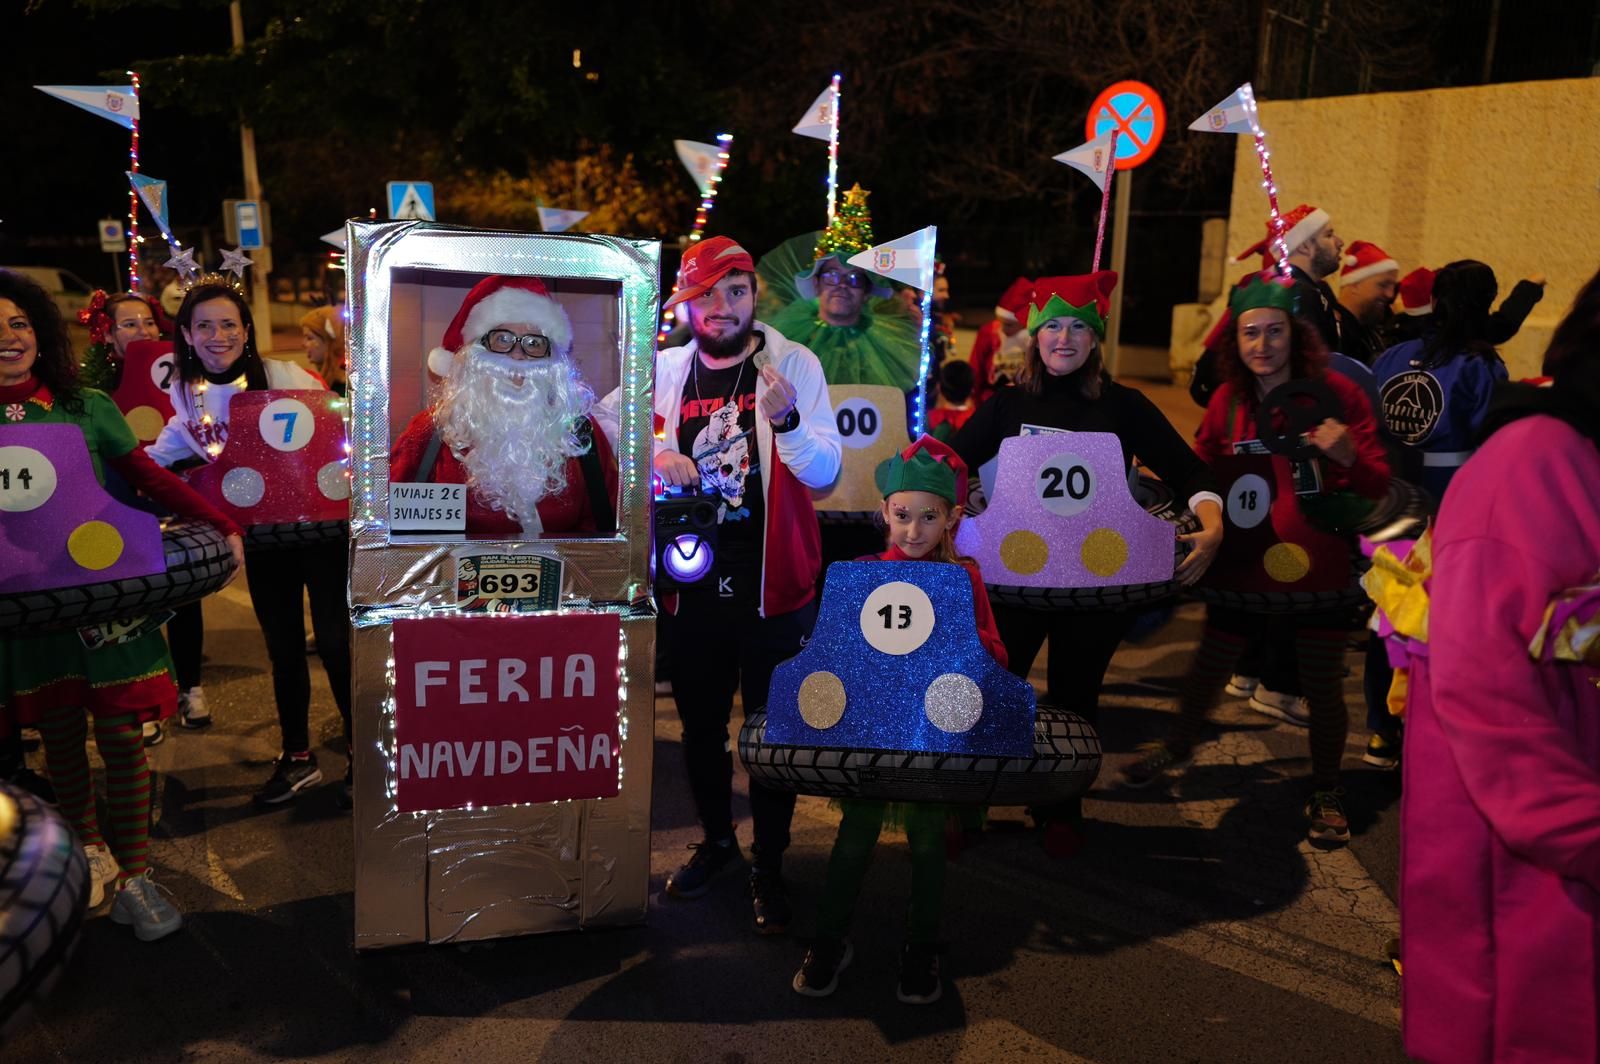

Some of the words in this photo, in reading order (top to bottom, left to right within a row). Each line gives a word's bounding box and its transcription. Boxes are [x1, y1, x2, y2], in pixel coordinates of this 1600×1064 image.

[836, 407, 877, 437] 00
[1384, 402, 1432, 421] TROPICAL
[272, 412, 299, 444] 7
[0, 467, 33, 490] 14
[1040, 465, 1091, 500] 20
[1238, 490, 1258, 511] 18
[480, 573, 538, 594] 693
[877, 604, 912, 629] 13
[414, 654, 596, 707] FERIA
[400, 724, 612, 779] NAVIDEÑA
